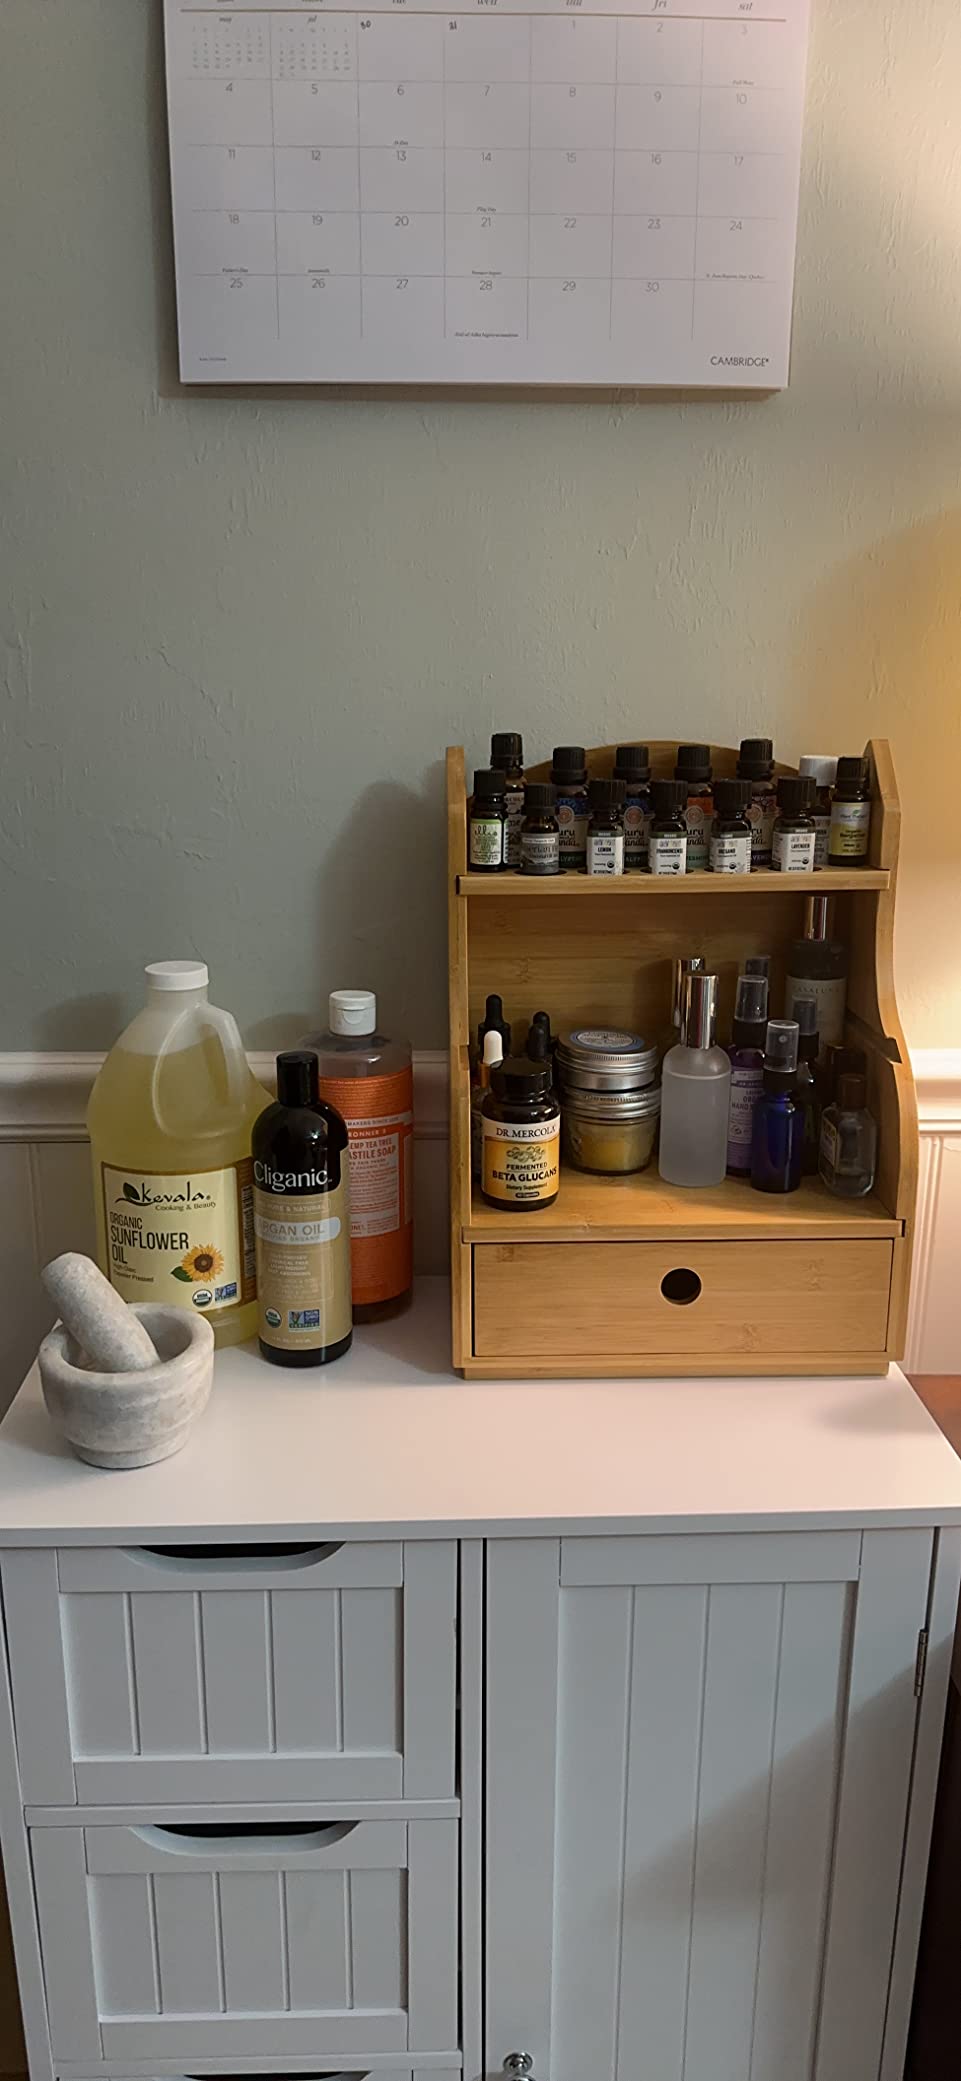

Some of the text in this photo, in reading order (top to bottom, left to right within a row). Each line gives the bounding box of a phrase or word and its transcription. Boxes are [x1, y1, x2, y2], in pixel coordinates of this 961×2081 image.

[739, 2, 753, 11] sat
[656, 22, 664, 32] 2
[225, 83, 748, 104] 4 5 6 7 8 9 10
[228, 149, 744, 166] 11 12 13 14 15 16 17
[228, 215, 743, 230] 18 19 20 21 22 23 24
[229, 278, 660, 292] 25 26 27 28 29 30
[560, 829, 575, 838] uru
[687, 829, 704, 838] uru
[350, 1137, 392, 1150] EMP TEA TREE
[349, 1145, 396, 1160] ASTILE SOAP
[506, 1161, 548, 1171] FERMENTED
[254, 1160, 328, 1192] Cliganic
[492, 1166, 557, 1182] BETA GLUCANS
[155, 1203, 184, 1212] Cooking
[194, 1201, 216, 1209] Beauty
[109, 1211, 143, 1230] ORGANIC
[302, 1224, 325, 1236] OIL
[110, 1225, 189, 1250] SUNFLOWER
[111, 1244, 128, 1265] OIL
